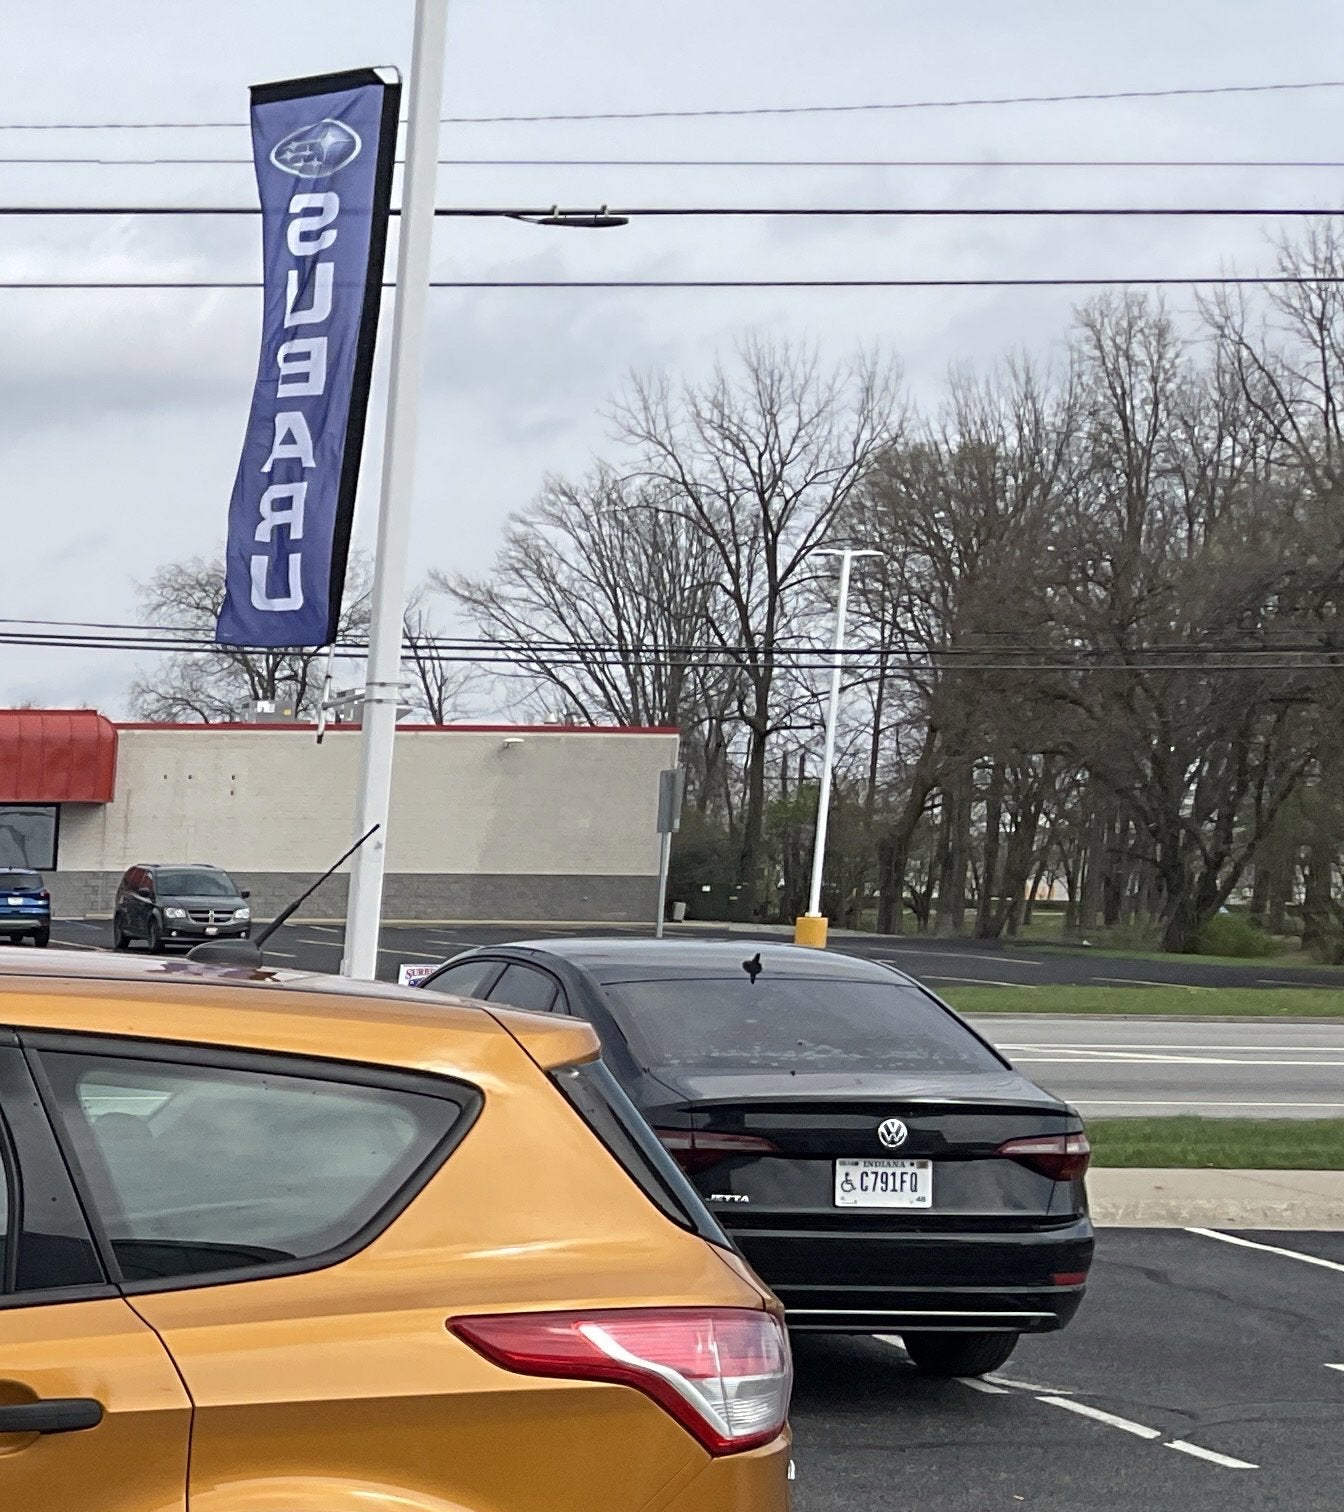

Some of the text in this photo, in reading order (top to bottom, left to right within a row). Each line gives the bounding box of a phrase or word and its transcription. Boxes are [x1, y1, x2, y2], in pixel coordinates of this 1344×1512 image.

[863, 1160, 906, 1168] INDIANA
[860, 1171, 918, 1193] C791FQ
[705, 1193, 750, 1203] JETTA
